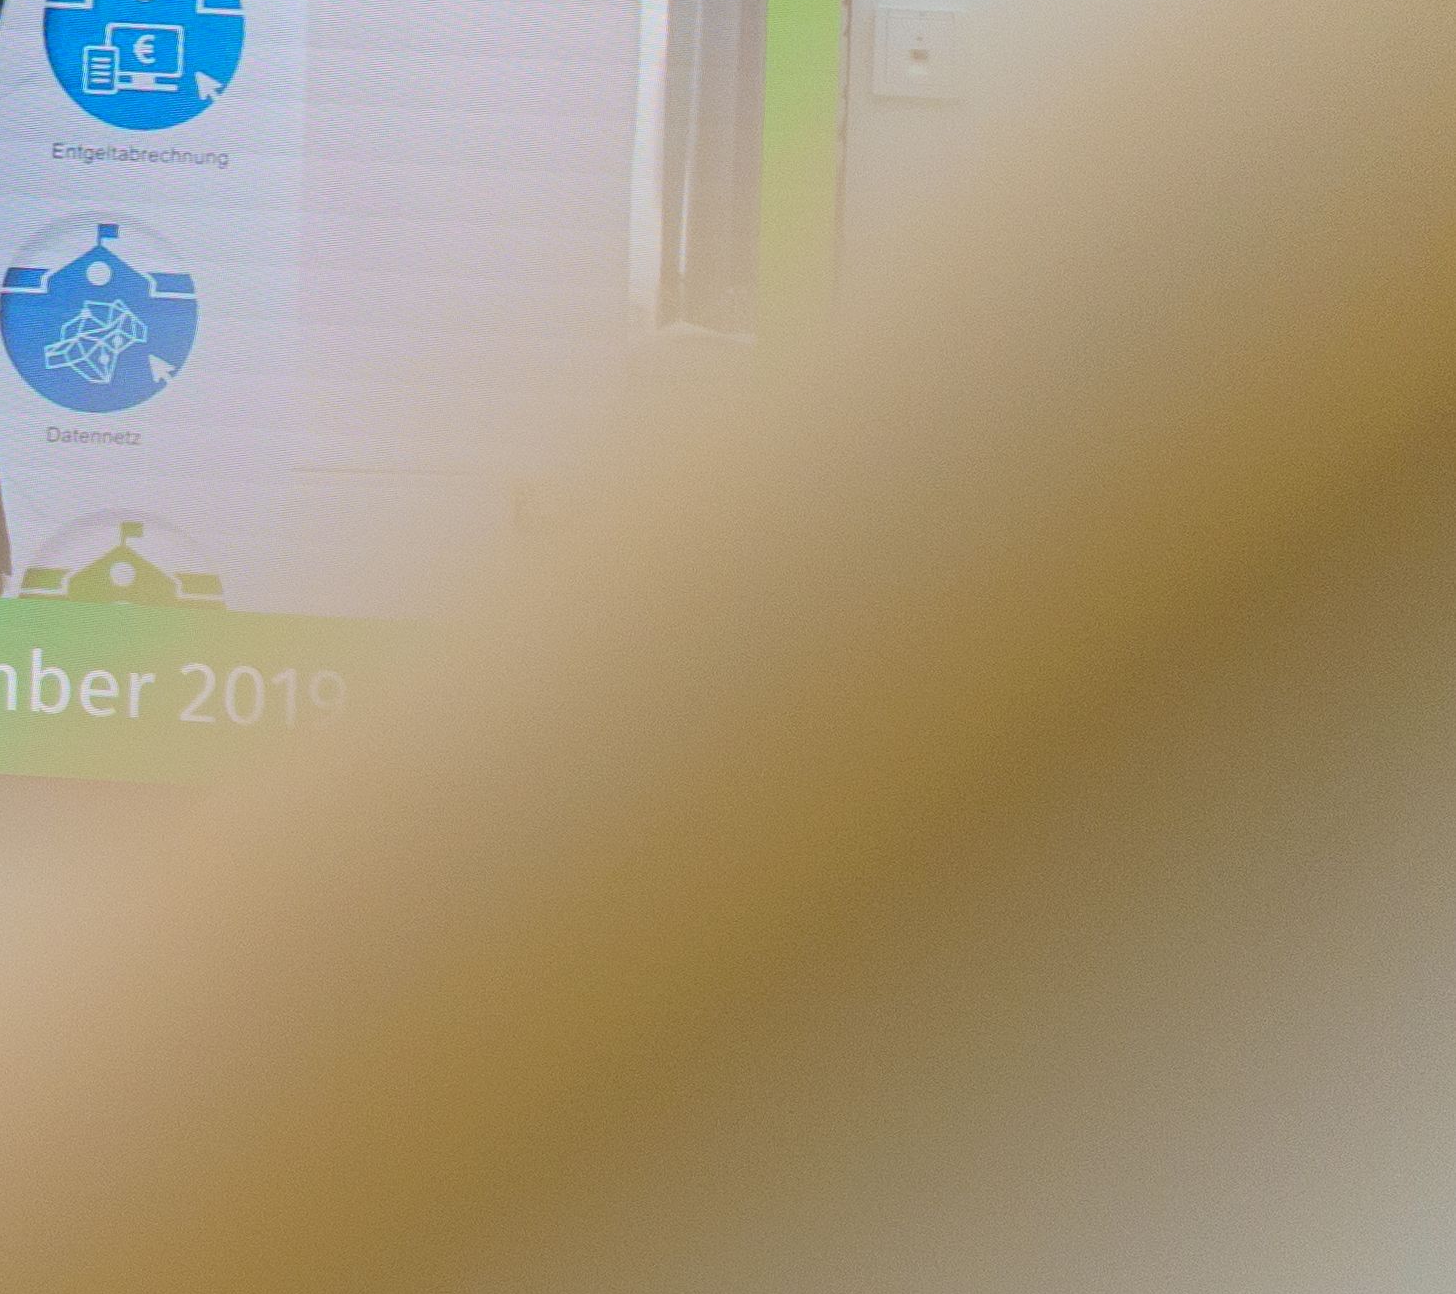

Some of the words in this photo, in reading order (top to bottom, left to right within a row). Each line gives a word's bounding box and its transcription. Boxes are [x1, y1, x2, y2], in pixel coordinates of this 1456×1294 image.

[52, 142, 229, 169] Entgeltabrechnung
[46, 426, 143, 446] Datennetz
[178, 661, 347, 733] 2019
